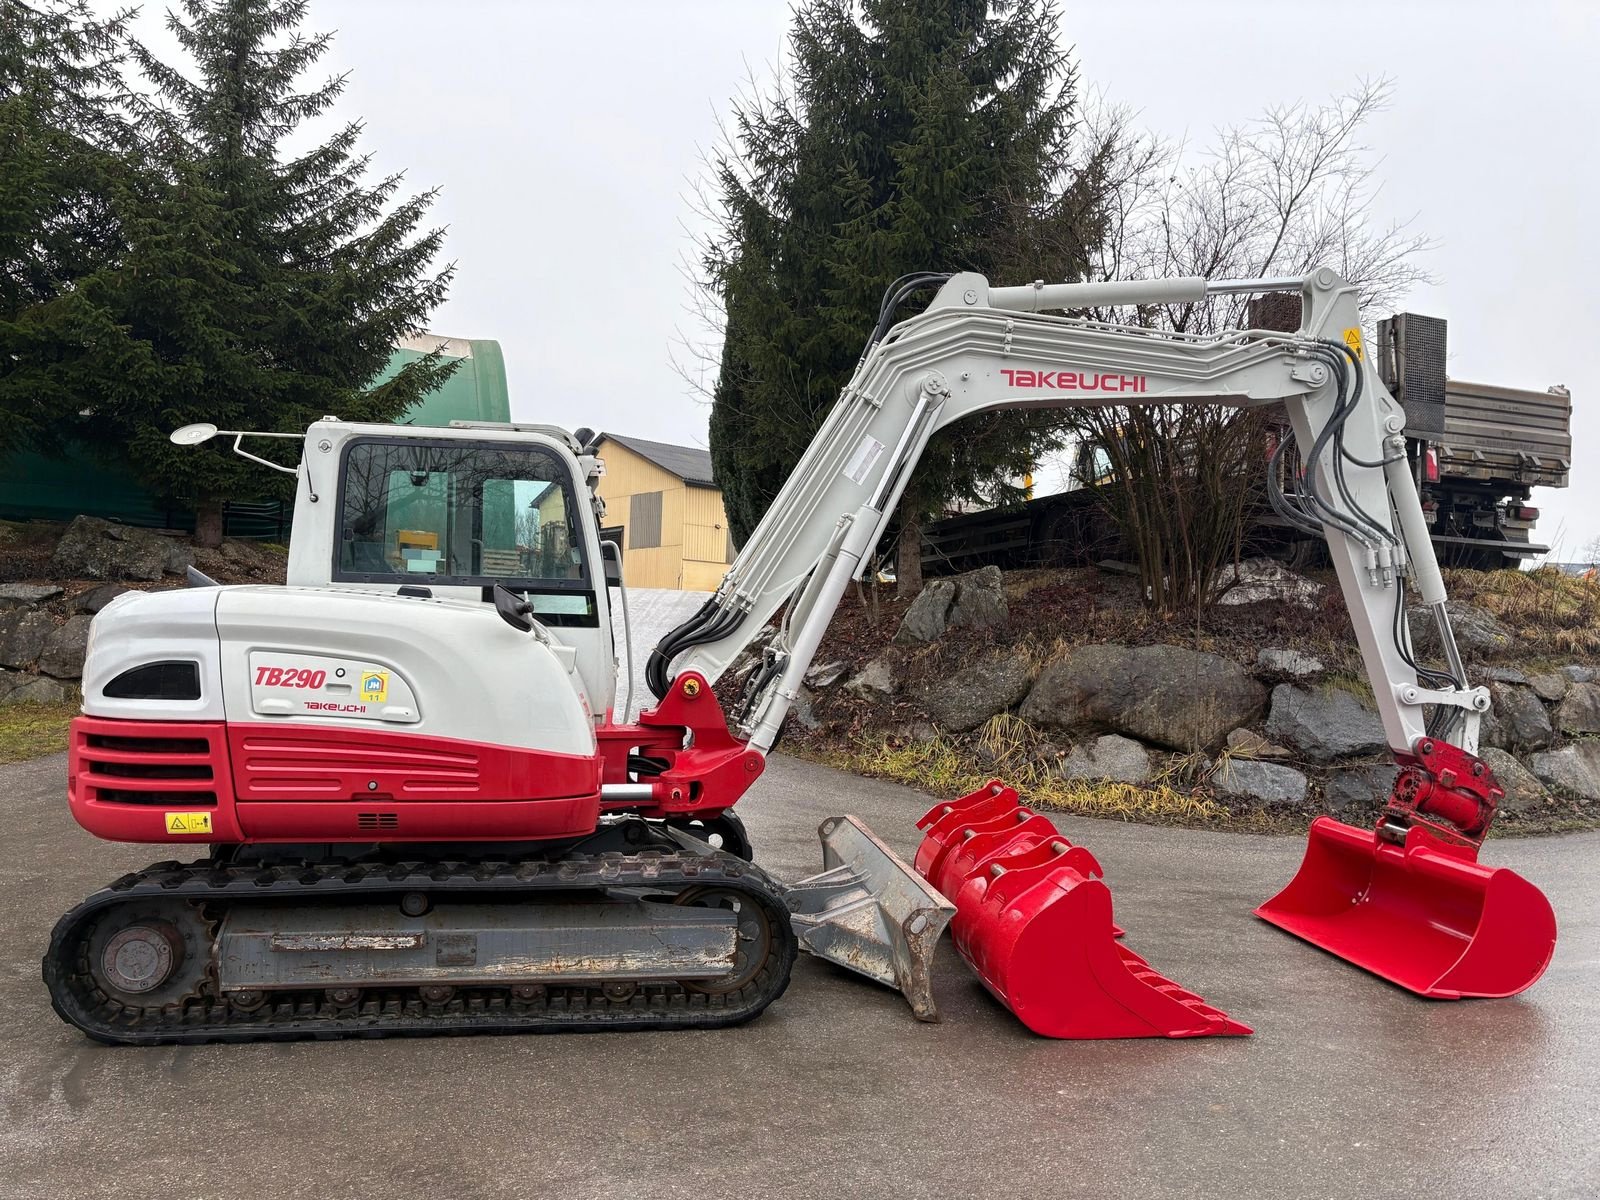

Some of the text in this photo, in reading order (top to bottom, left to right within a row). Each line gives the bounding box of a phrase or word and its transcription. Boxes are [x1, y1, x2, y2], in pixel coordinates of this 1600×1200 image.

[1000, 369, 1146, 392] TAKEUCHI
[255, 666, 326, 689] TB290
[304, 701, 366, 713] TAKEUCHI
